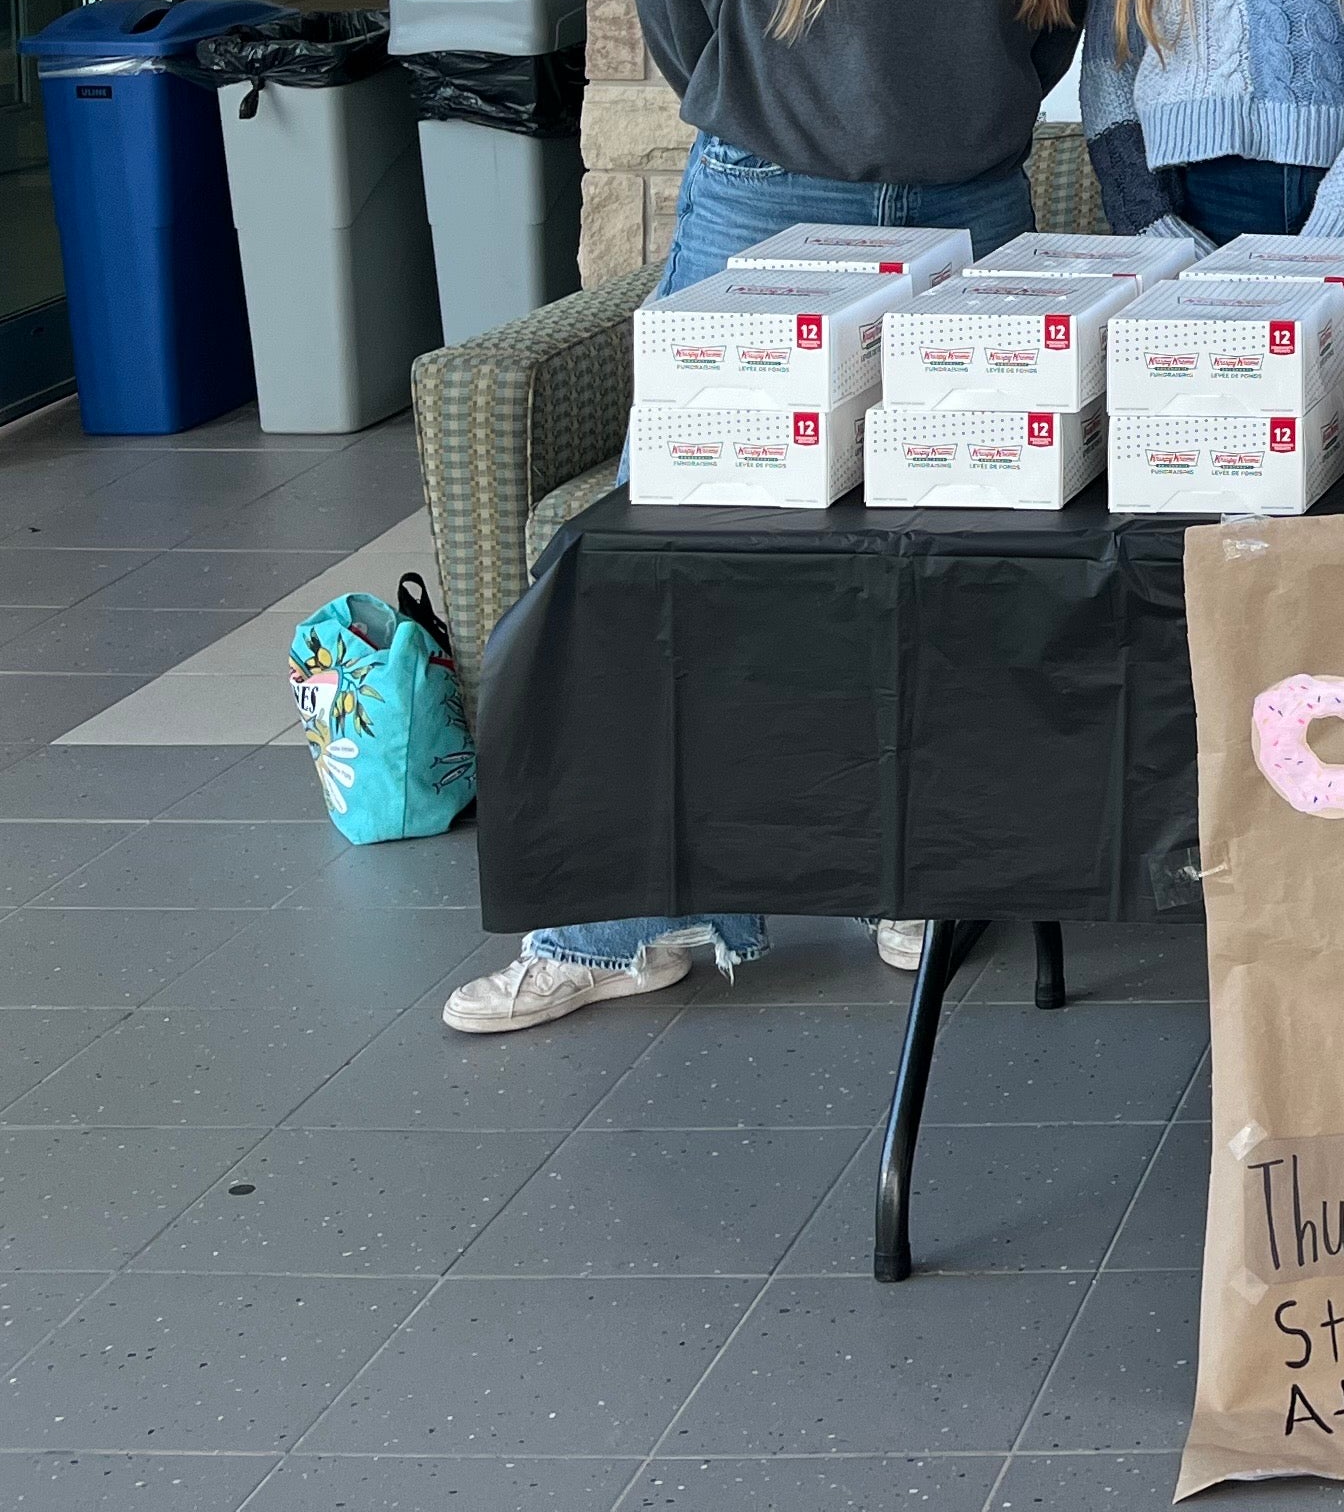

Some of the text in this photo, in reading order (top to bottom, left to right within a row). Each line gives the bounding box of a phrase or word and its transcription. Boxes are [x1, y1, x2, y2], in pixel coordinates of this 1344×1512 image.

[801, 325, 818, 339] 12
[1274, 331, 1290, 345] 12
[798, 421, 814, 435] 12
